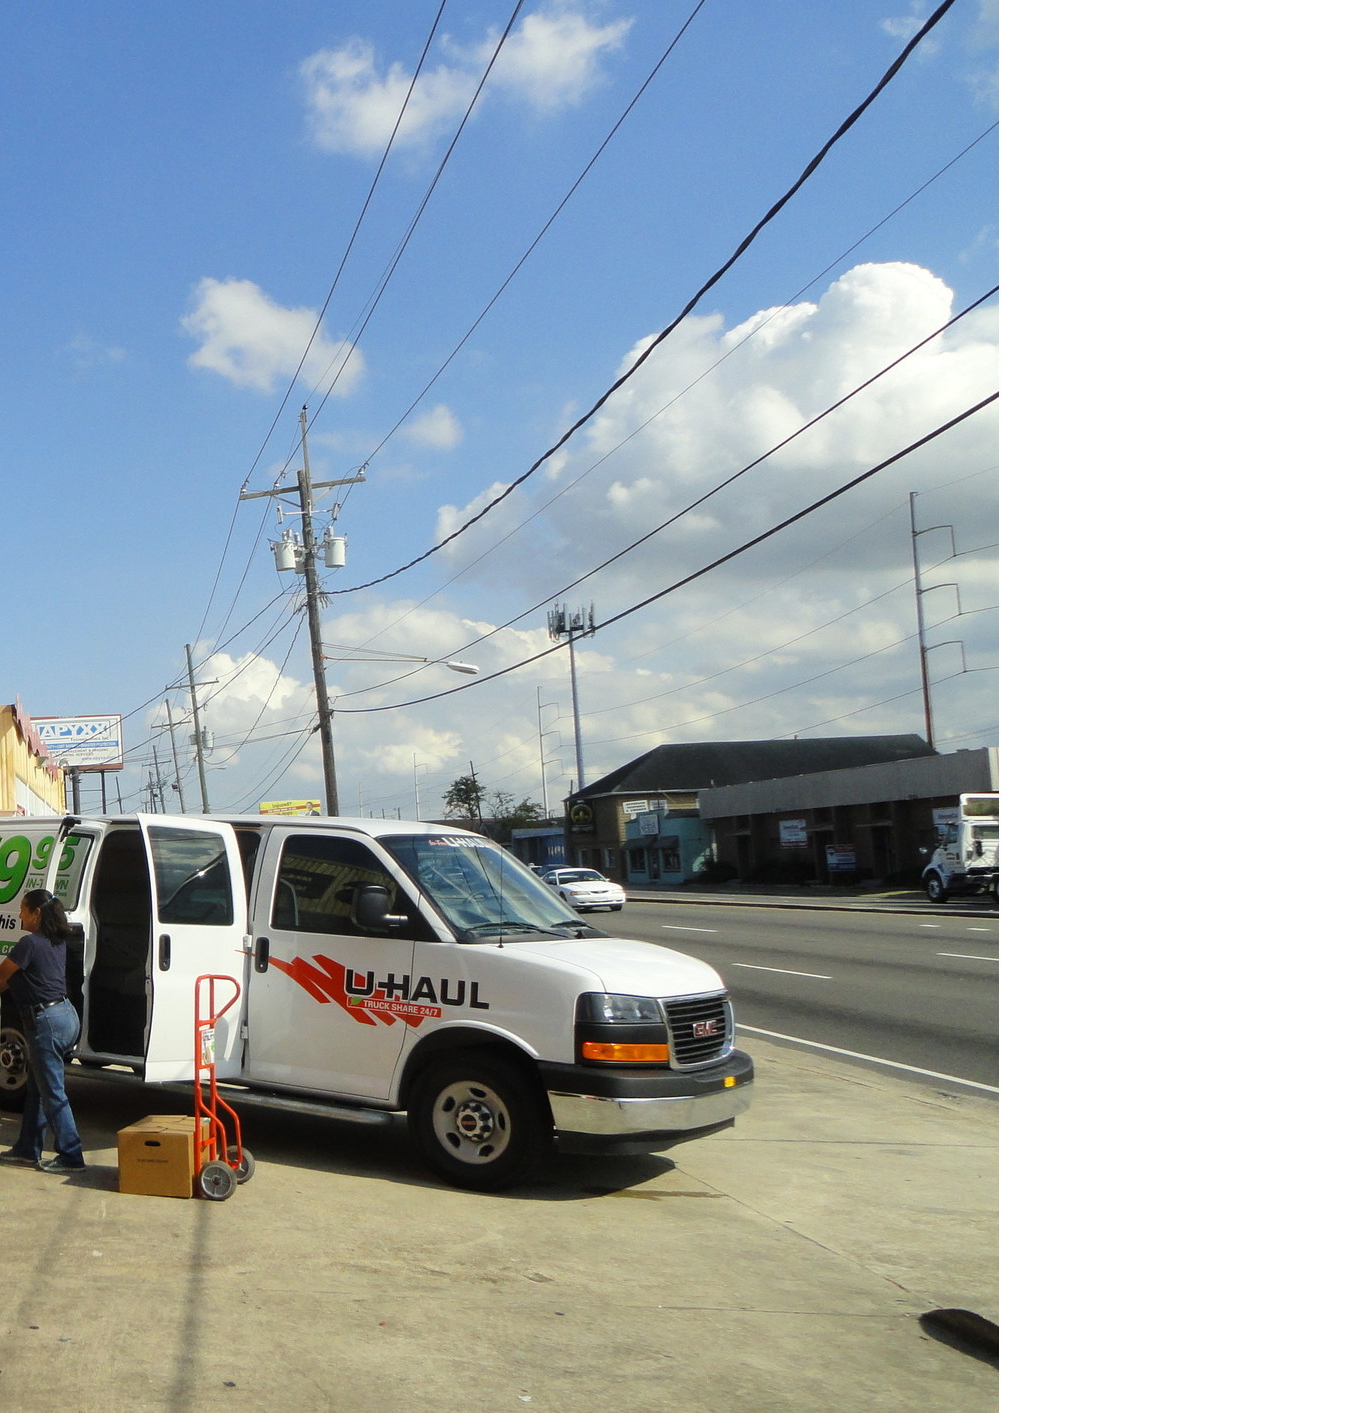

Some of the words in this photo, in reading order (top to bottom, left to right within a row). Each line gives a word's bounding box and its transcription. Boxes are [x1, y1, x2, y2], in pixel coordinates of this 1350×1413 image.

[345, 969, 490, 1009] U-HAUL
[363, 1000, 390, 1010] TRUCK
[391, 1003, 419, 1013] SHARE
[420, 1007, 438, 1016] 24/7
[693, 1020, 718, 1038] GMC
